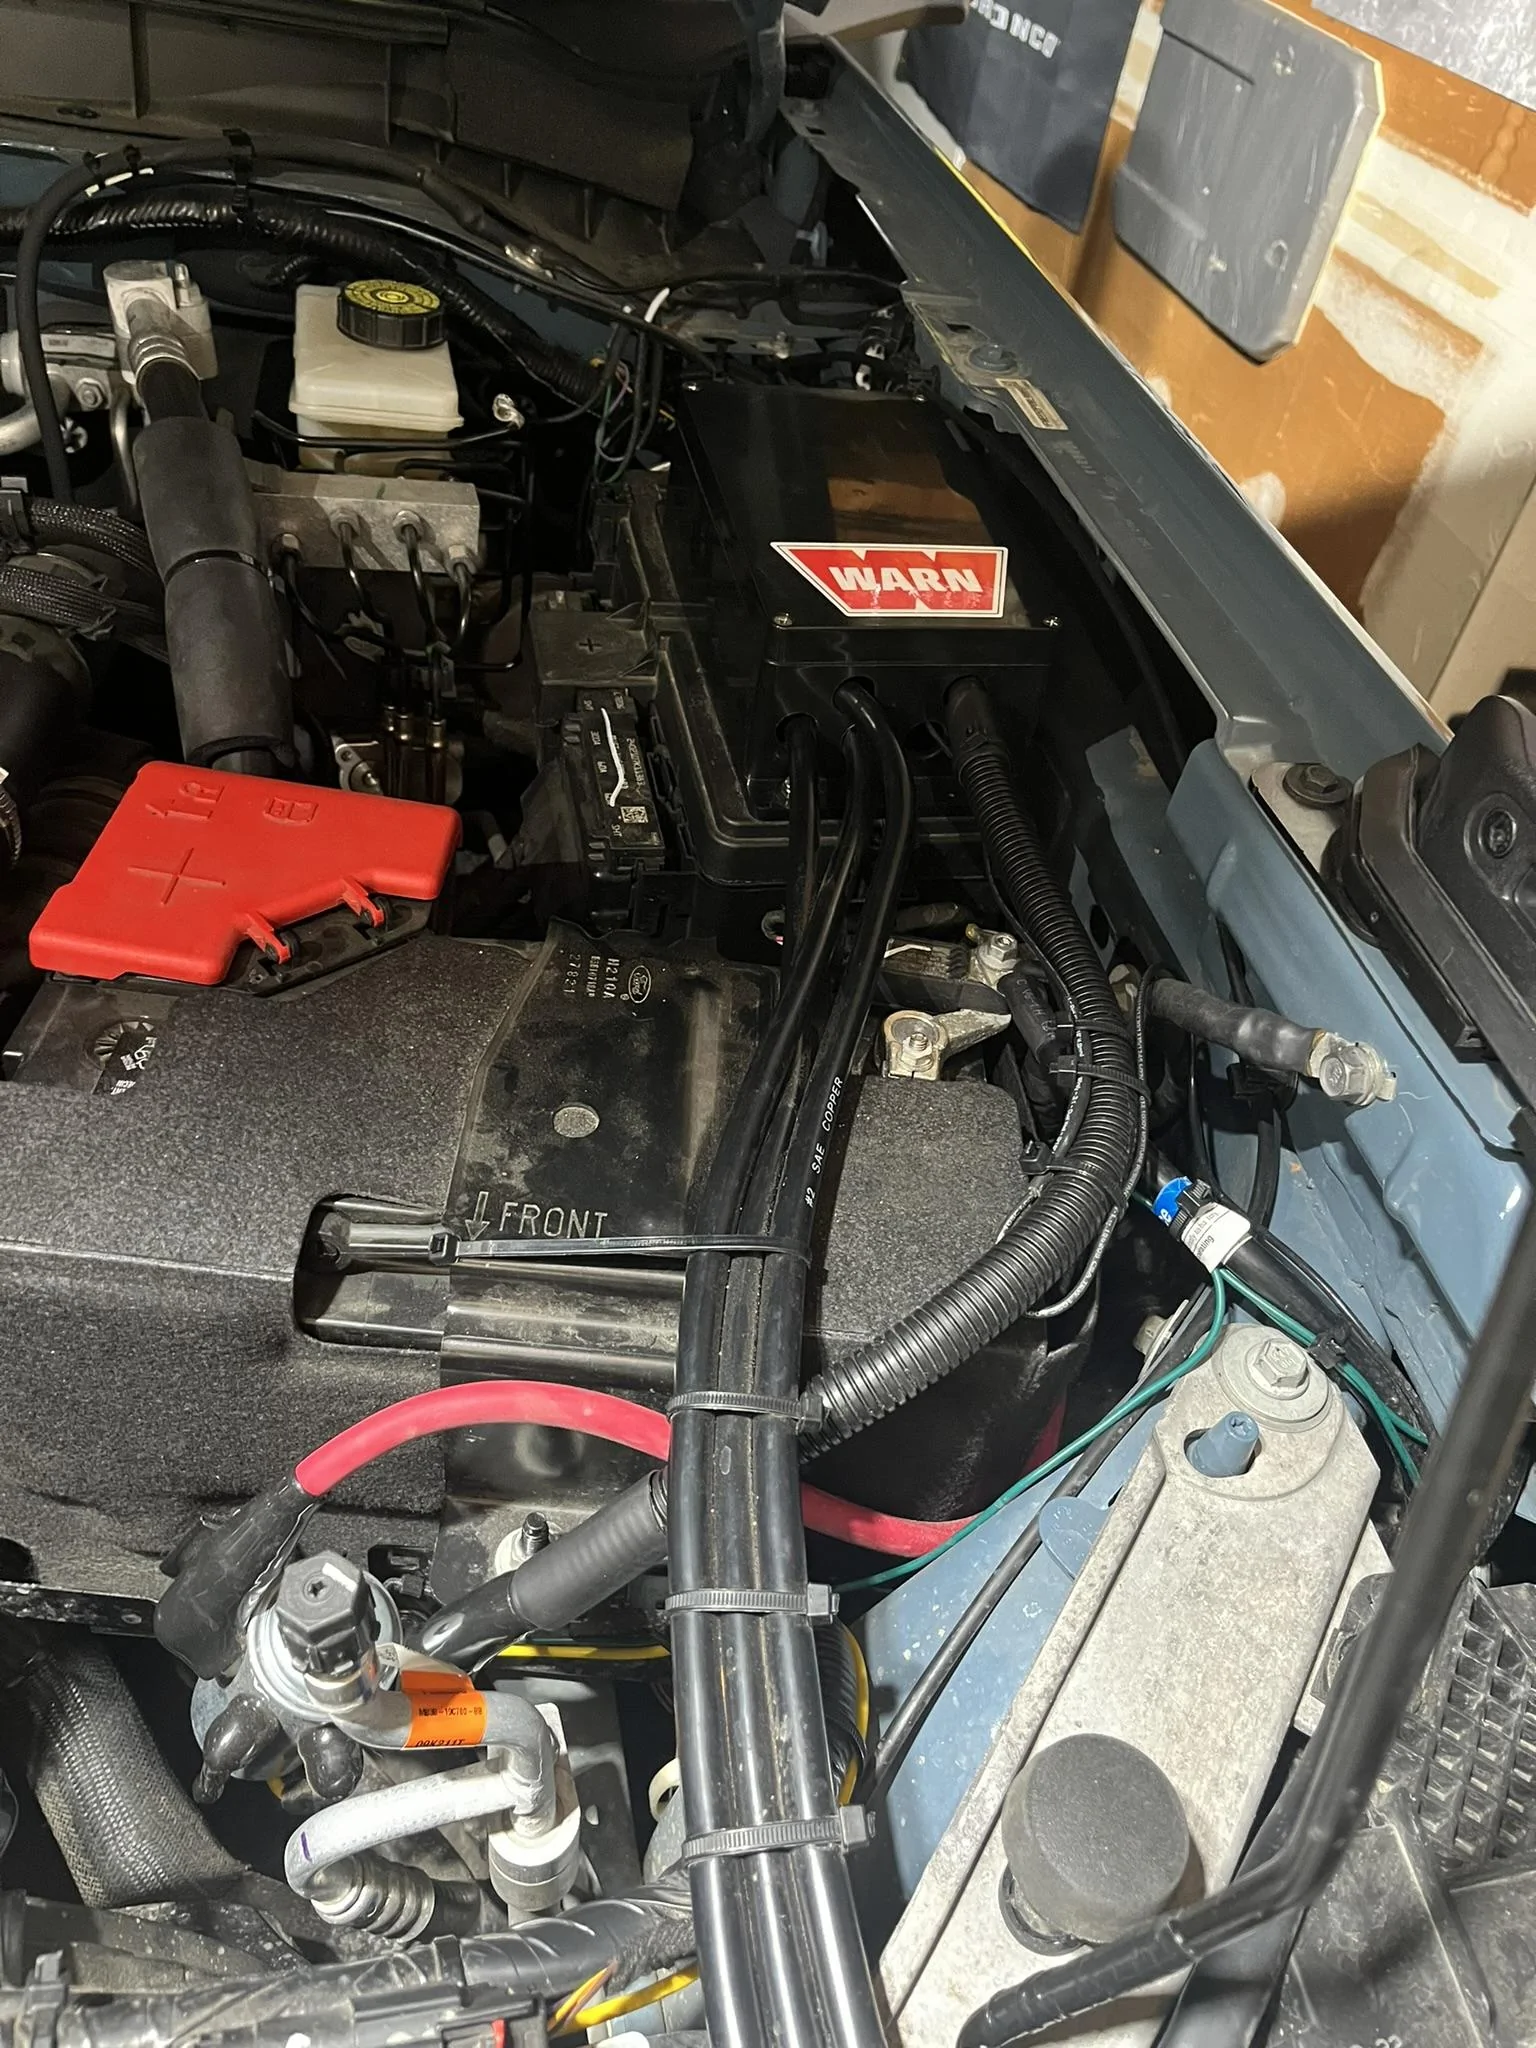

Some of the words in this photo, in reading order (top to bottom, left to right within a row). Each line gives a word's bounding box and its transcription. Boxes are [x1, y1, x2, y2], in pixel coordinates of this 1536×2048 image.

[828, 566, 984, 593] WARN
[602, 957, 620, 998] H210A
[804, 1187, 816, 1208] #2
[811, 1142, 826, 1174] SAE
[822, 1076, 843, 1132] COPPER
[498, 1201, 608, 1239] FRONT
